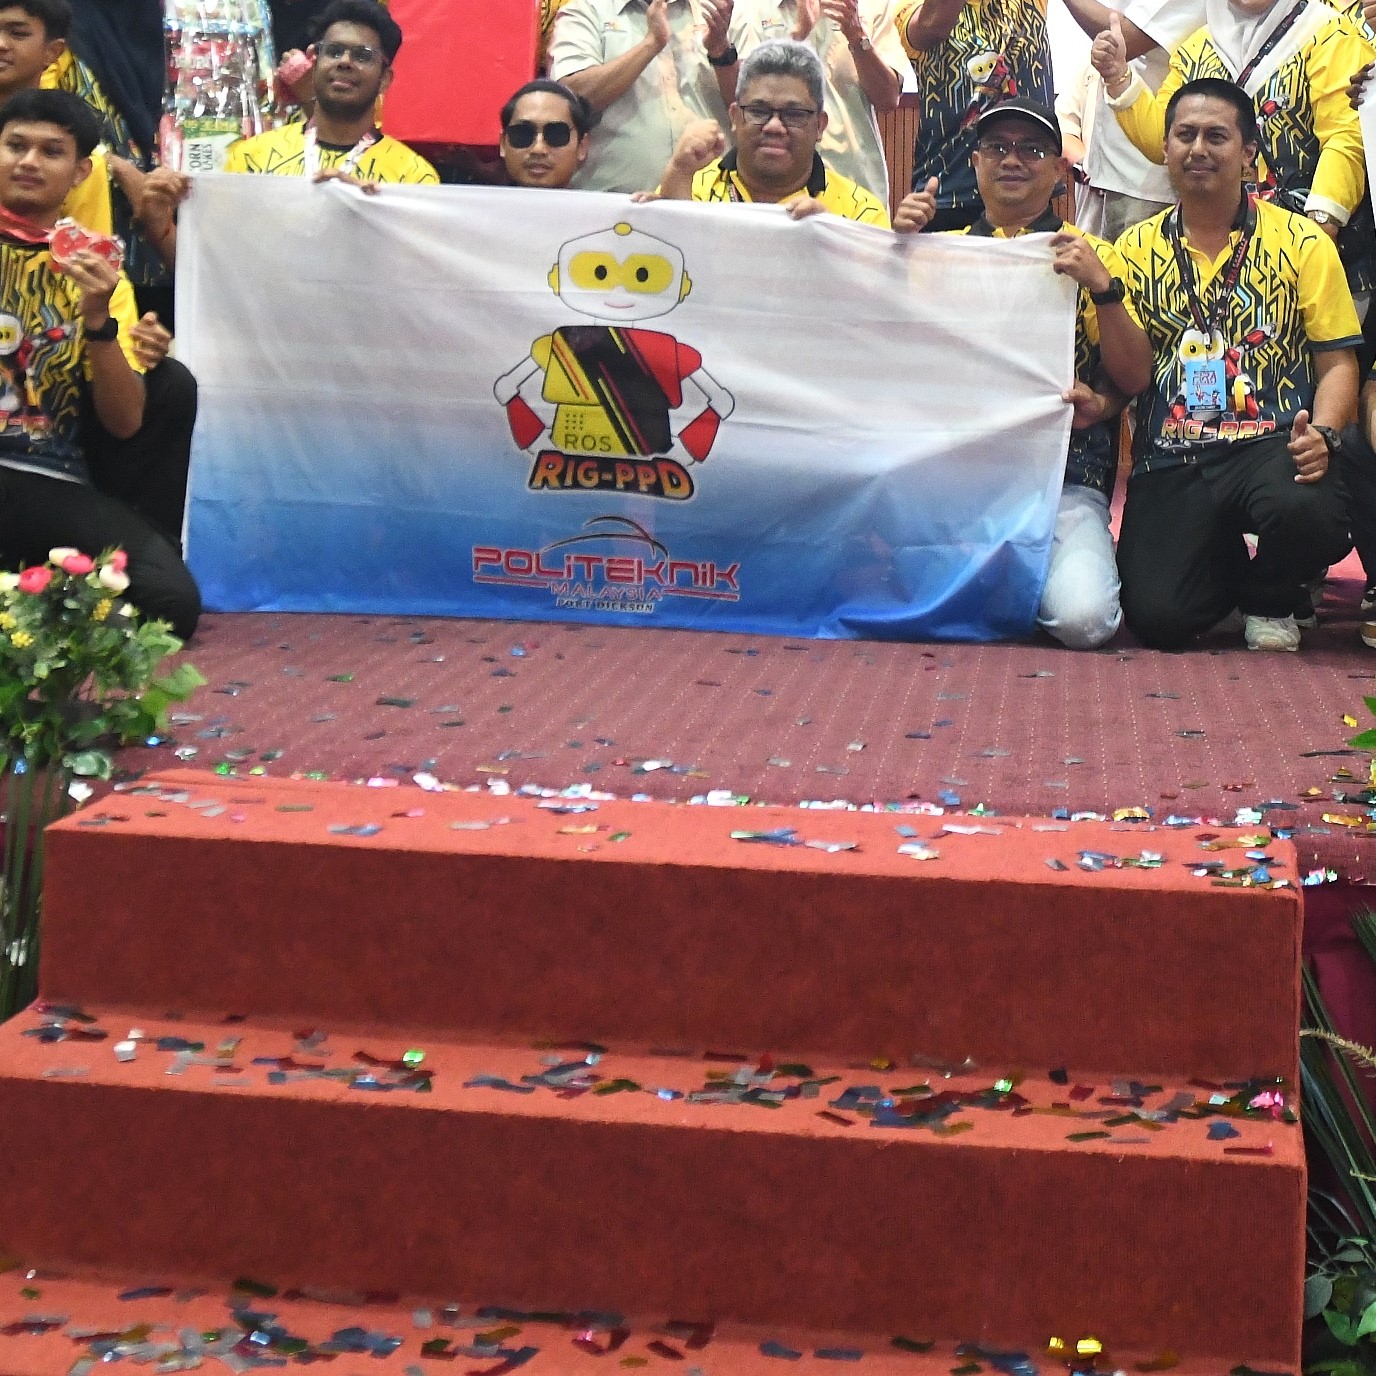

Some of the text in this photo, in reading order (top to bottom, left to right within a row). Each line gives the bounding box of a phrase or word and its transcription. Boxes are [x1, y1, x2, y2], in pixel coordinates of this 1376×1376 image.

[187, 143, 202, 171] ORN
[564, 433, 612, 453] ROS
[532, 453, 692, 500] RIG-PPD
[549, 582, 664, 602] MALAYSIA
[556, 598, 656, 613] PORT DICKSON
